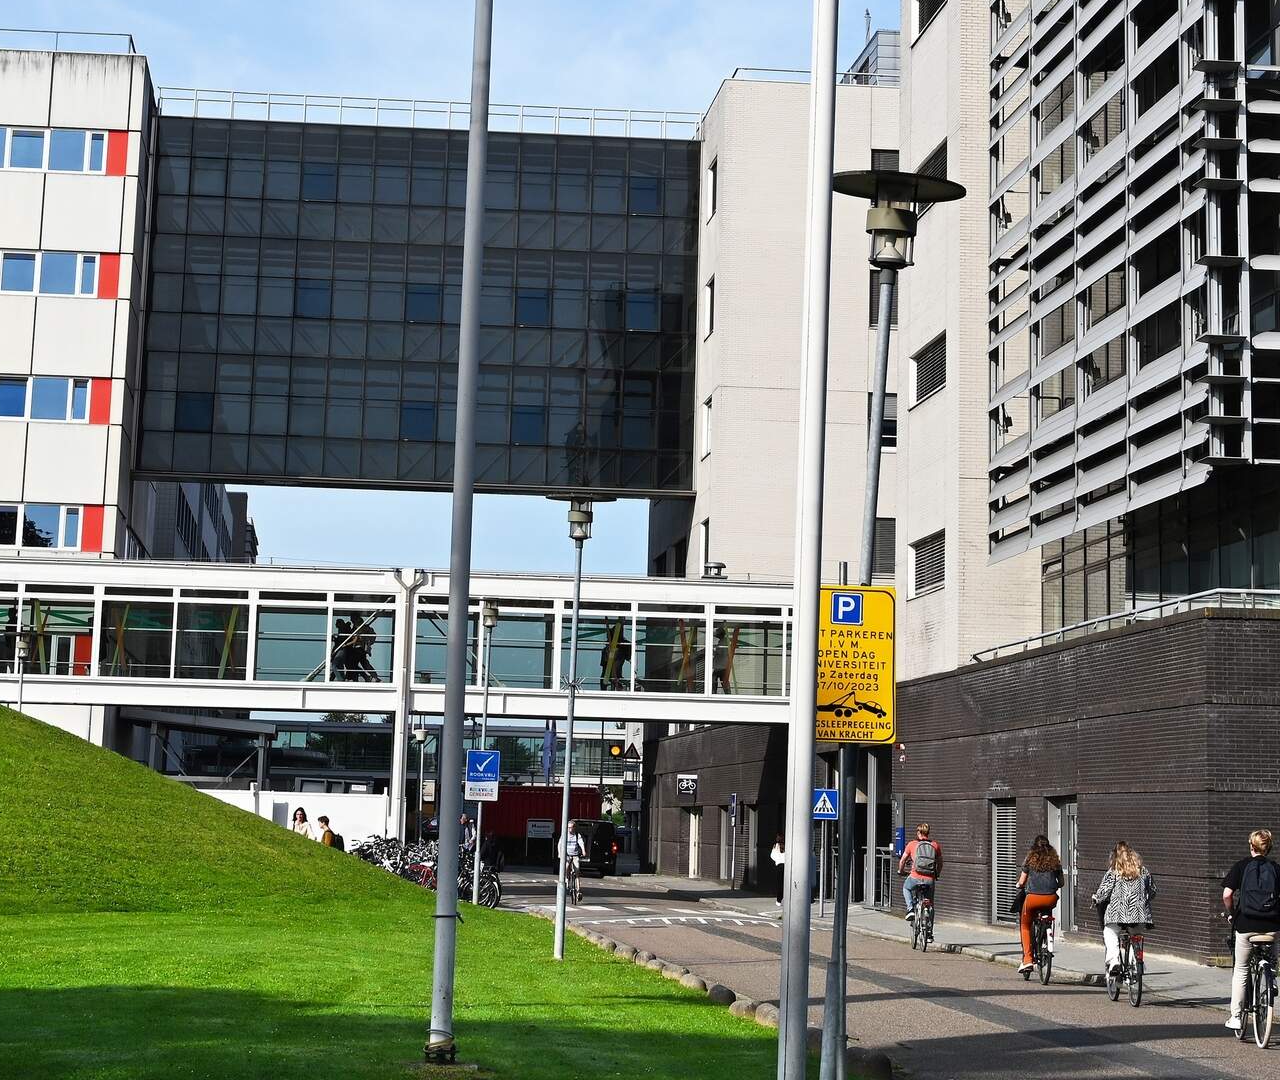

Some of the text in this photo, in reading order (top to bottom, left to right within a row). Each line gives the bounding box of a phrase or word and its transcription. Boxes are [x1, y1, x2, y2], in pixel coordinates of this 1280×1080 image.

[838, 596, 856, 620] P
[830, 630, 893, 640] PARKEREN
[817, 649, 876, 659] OPEN DAG
[816, 659, 887, 670] NIVERSITEIT
[830, 670, 879, 682] Zaterdag
[816, 720, 891, 730] GSLEEPREGELING
[817, 729, 874, 739] VAN KRACHT
